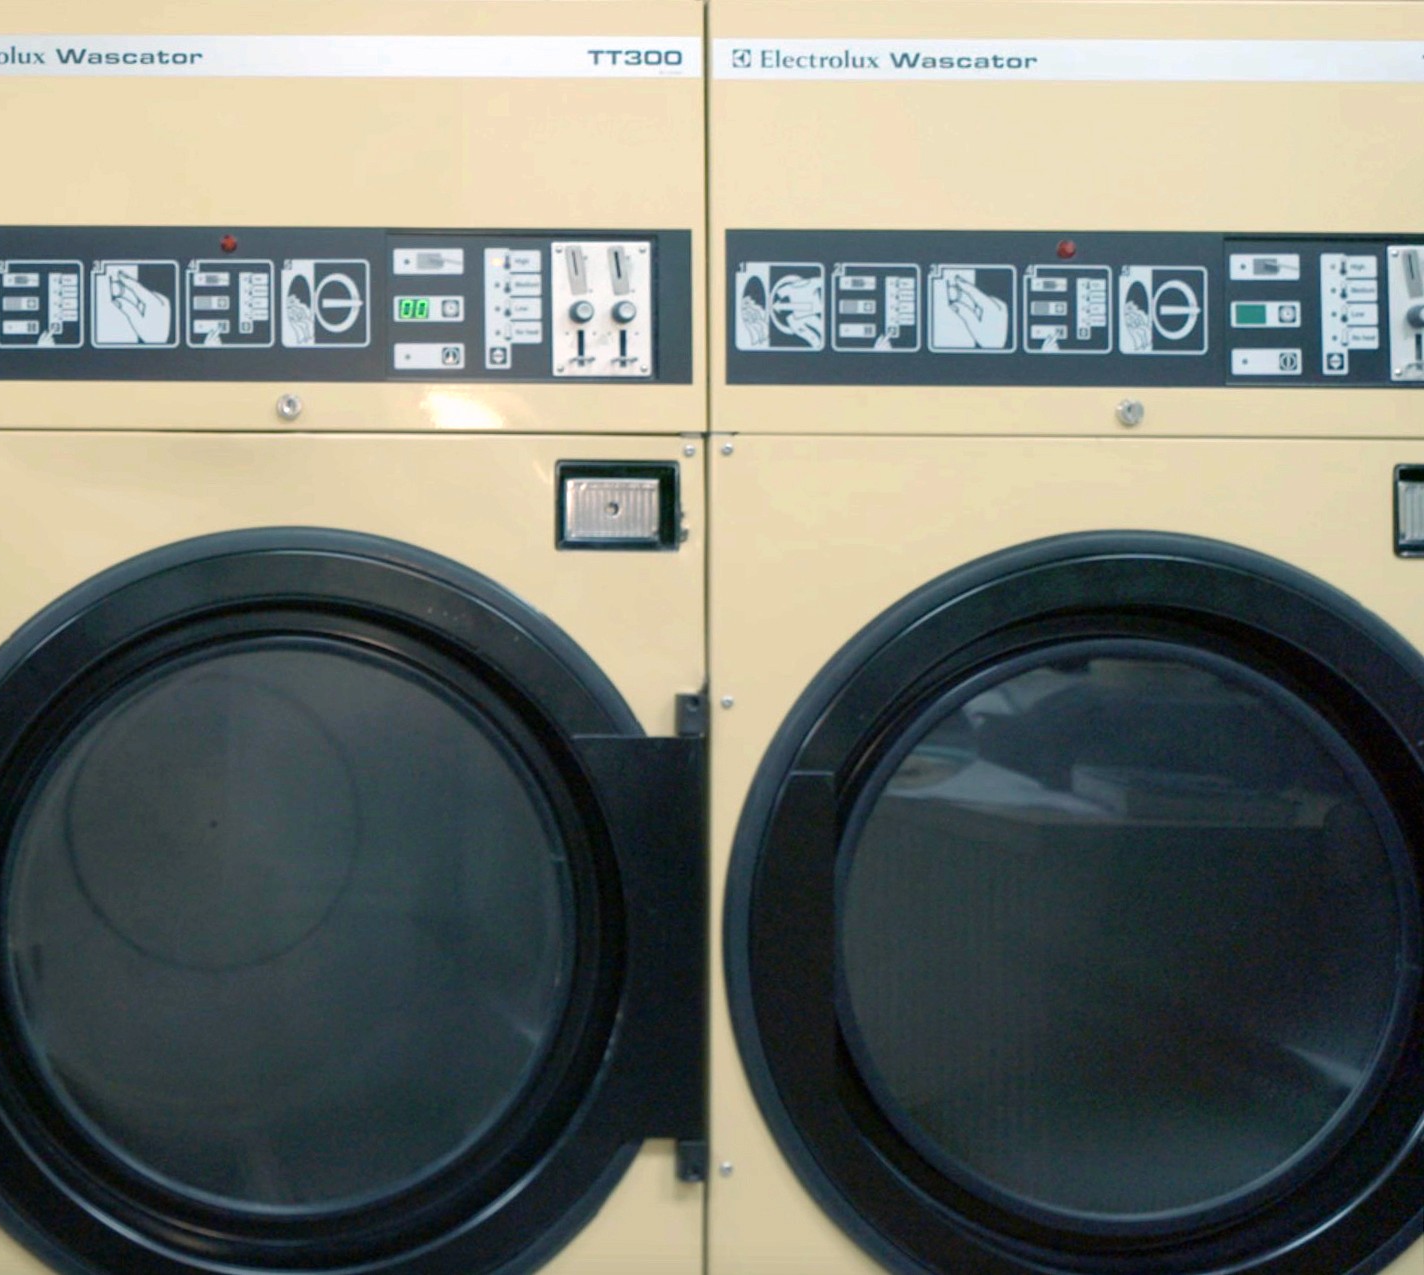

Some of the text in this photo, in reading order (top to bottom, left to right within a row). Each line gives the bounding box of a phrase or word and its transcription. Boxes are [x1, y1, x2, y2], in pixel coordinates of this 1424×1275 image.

[56, 48, 203, 65] Wascator
[587, 50, 683, 65] TT300
[761, 49, 1038, 69] Electrolux Wascator
[400, 299, 429, 319] 00
